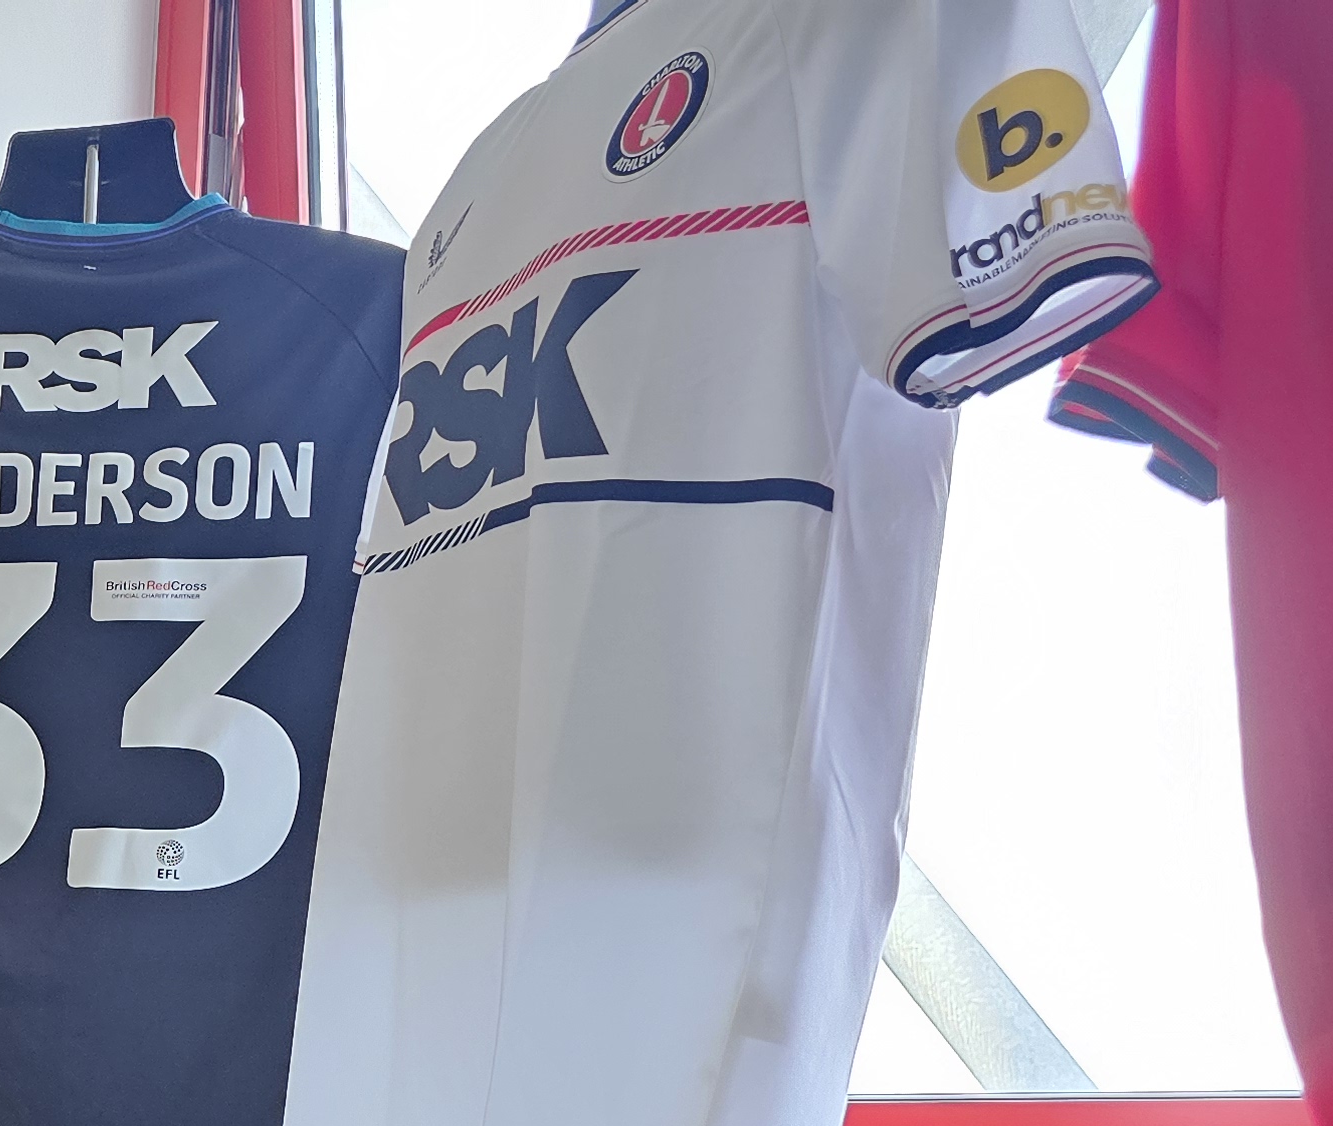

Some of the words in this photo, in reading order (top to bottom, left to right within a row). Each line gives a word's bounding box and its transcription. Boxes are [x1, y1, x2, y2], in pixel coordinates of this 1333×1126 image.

[642, 54, 704, 96] CHARLTON
[613, 141, 666, 173] ATHLETIC
[383, 268, 640, 526] RSK
[155, 867, 182, 880] EFL
